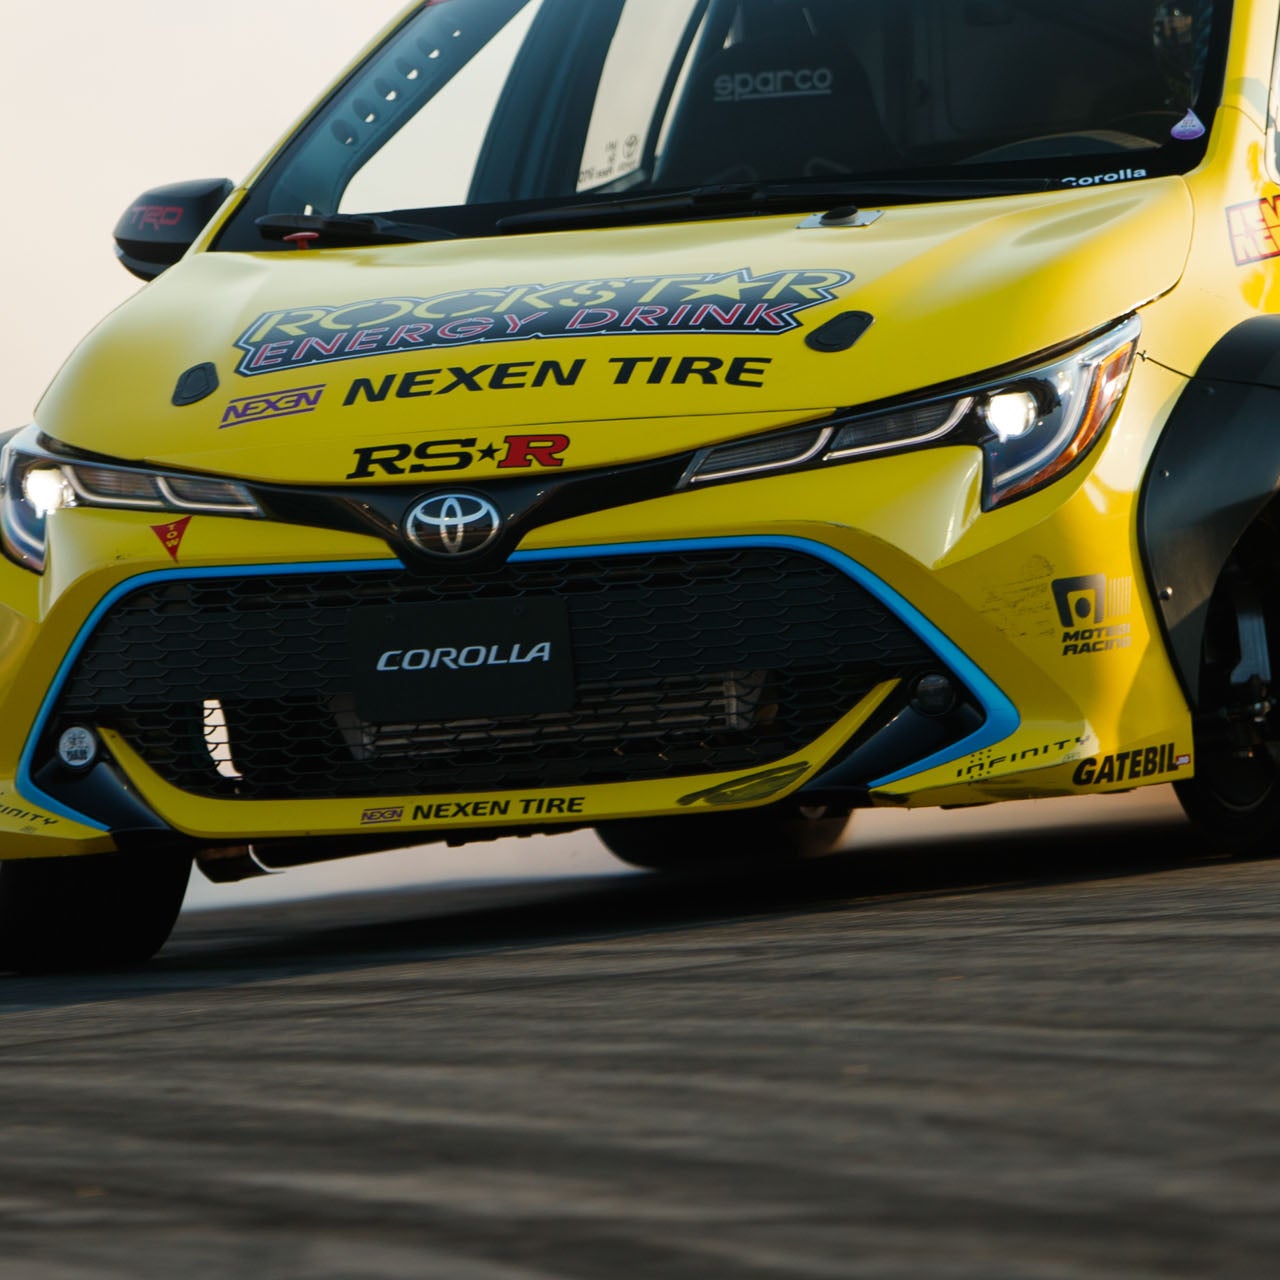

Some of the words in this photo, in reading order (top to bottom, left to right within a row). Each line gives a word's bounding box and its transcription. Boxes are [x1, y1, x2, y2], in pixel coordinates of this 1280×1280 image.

[713, 67, 833, 101] sparco
[129, 205, 185, 231] TRD
[251, 311, 549, 369] ENERGY
[564, 302, 801, 330] DRINK
[342, 359, 587, 407] NEXEN
[607, 356, 773, 388] TIRE
[376, 641, 551, 671] COROLLA
[956, 734, 1091, 778] INFINITY
[1072, 742, 1179, 786] GATEBIL
[412, 800, 511, 820] NEXEN
[519, 797, 585, 814] TIRE
